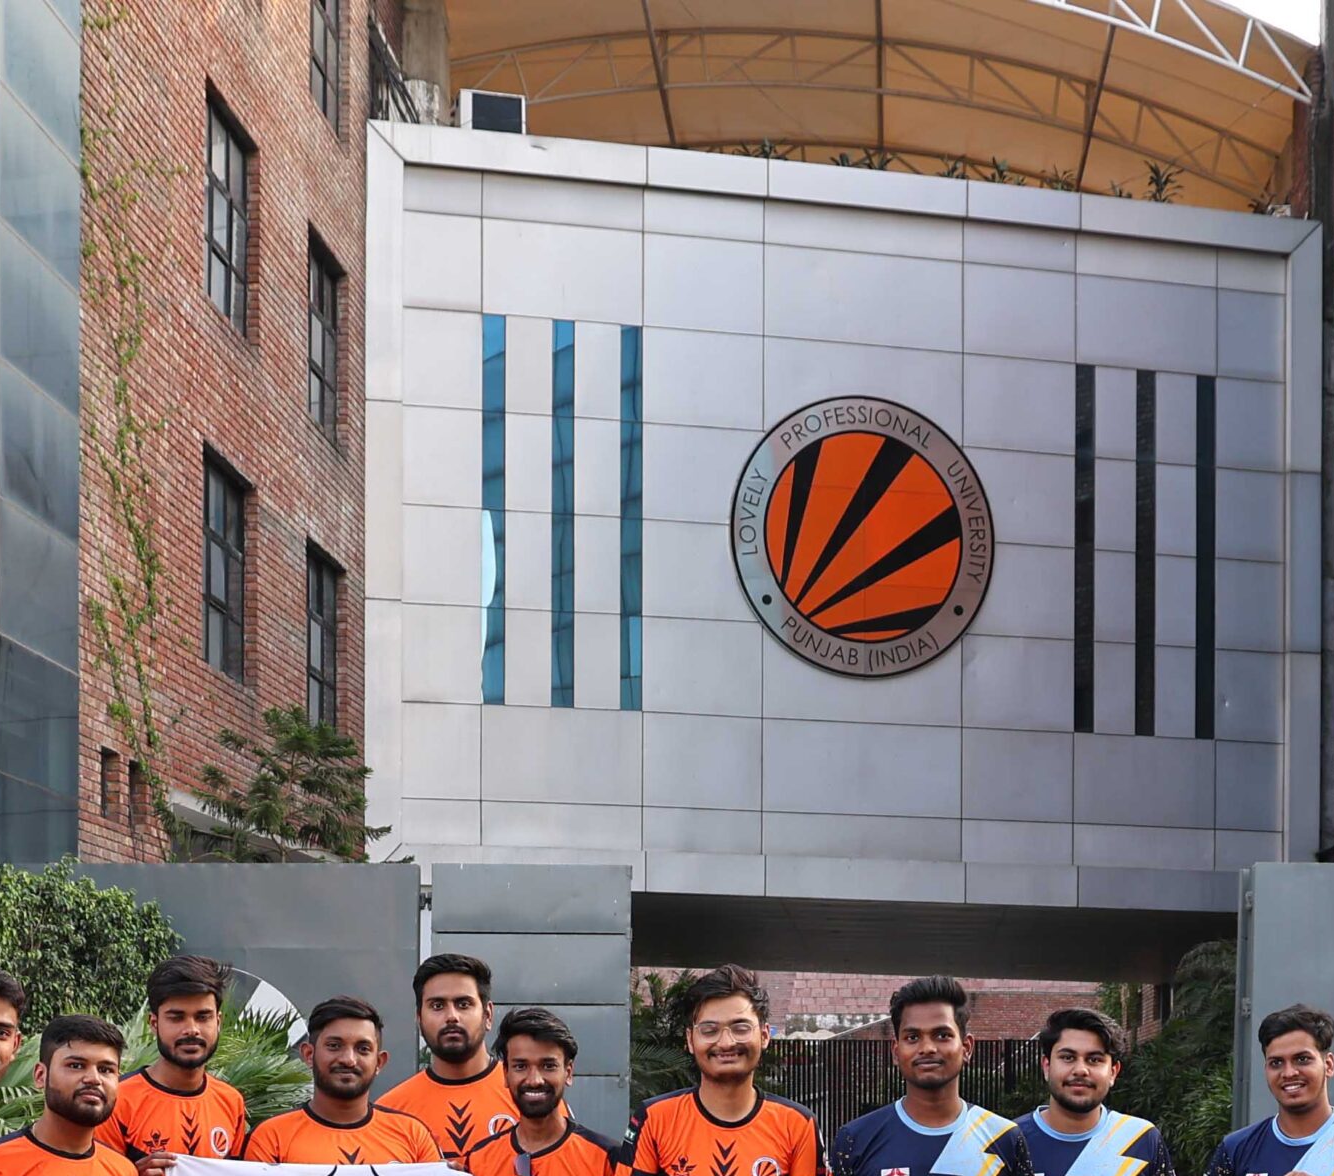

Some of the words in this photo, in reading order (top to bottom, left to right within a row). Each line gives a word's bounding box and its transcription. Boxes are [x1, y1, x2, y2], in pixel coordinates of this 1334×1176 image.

[739, 468, 768, 555] LOVELY
[780, 406, 932, 449] PROFESSIONAL
[947, 461, 986, 584] UNIVERSITY
[781, 616, 859, 666] PUNJAB
[868, 632, 939, 671] (INDIA)
